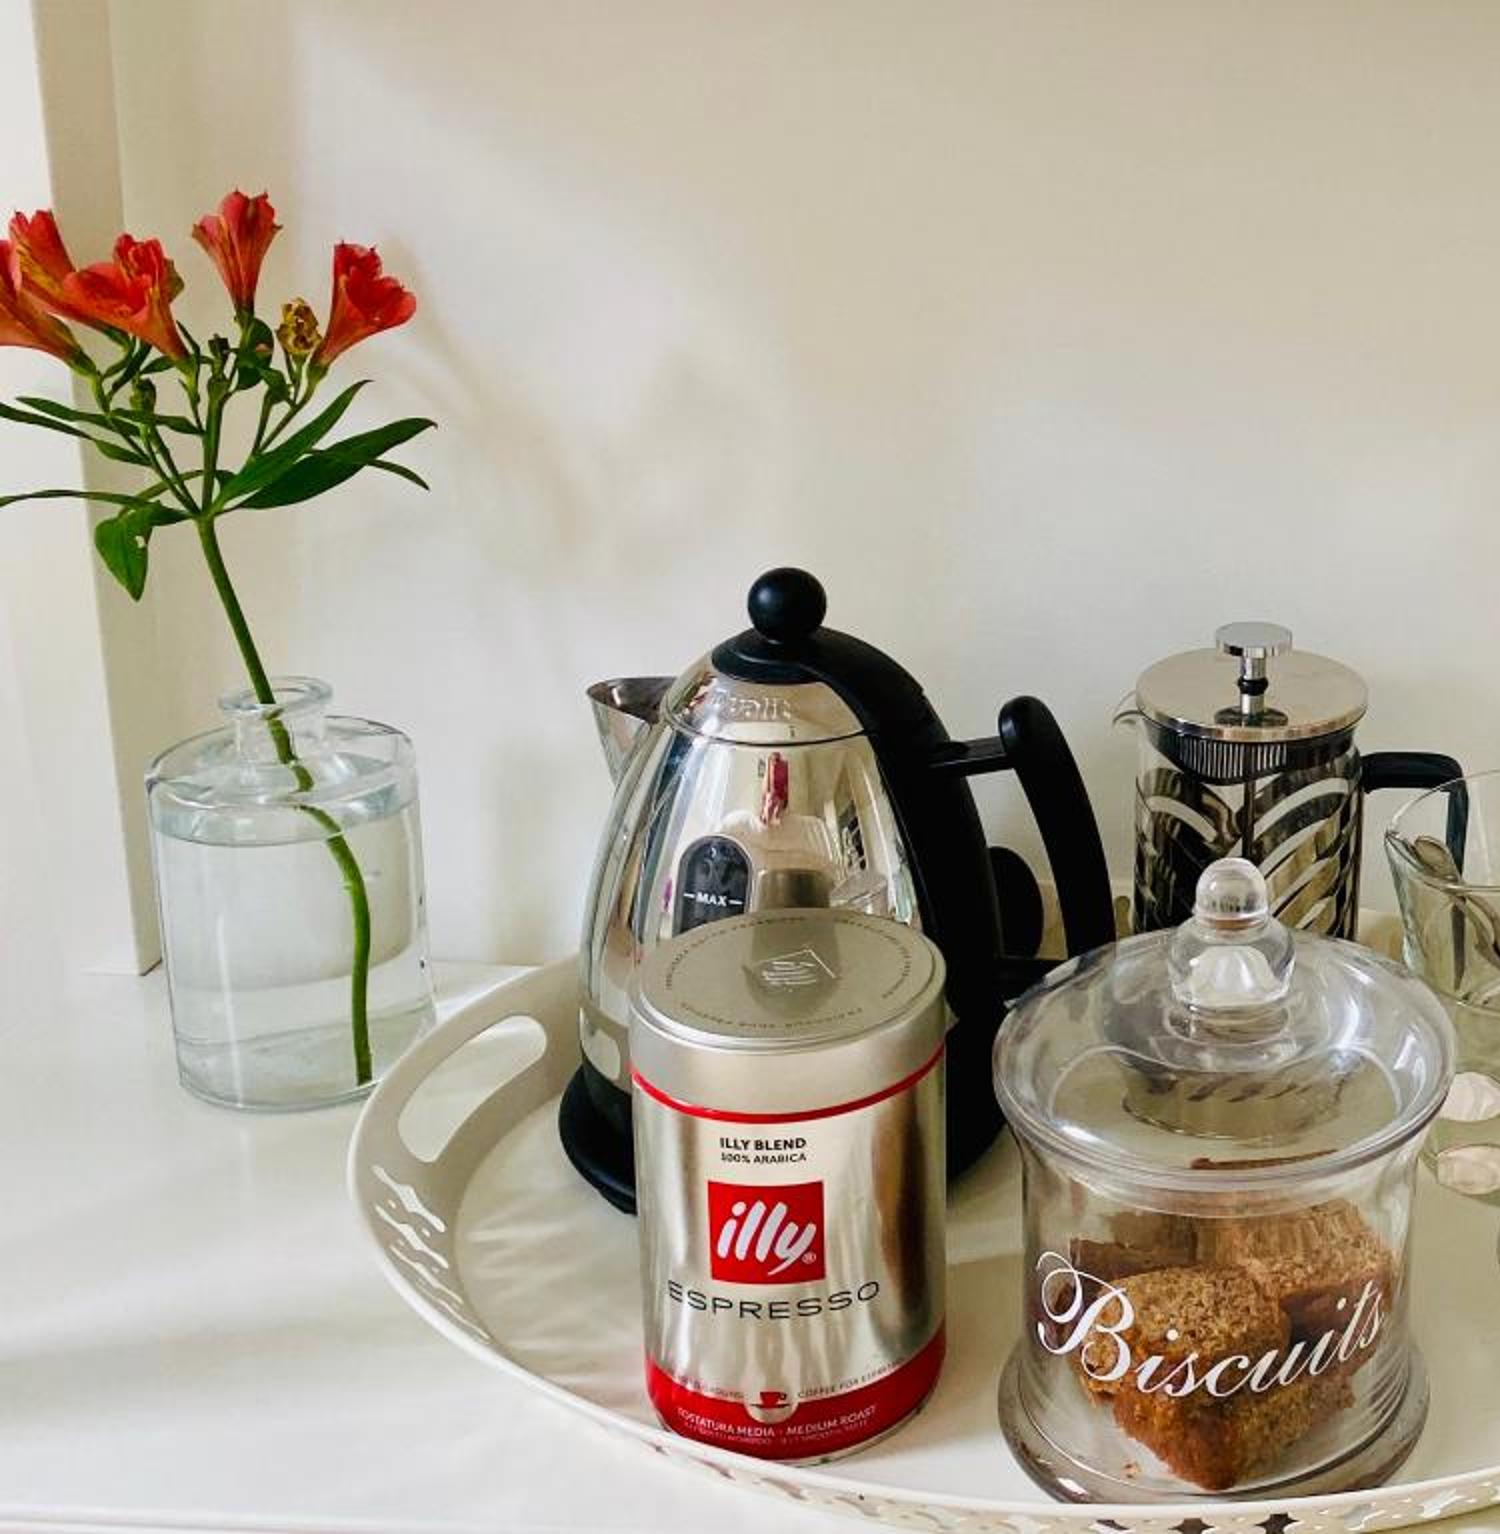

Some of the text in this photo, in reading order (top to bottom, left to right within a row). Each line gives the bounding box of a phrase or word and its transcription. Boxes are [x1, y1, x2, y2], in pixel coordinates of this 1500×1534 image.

[696, 891, 728, 907] MAX
[719, 1137, 807, 1151] ILLY BLEND
[753, 1153, 807, 1164] ARABICA
[717, 1200, 816, 1276] illy
[667, 1280, 881, 1320] ESPRESSO
[1036, 1251, 1385, 1398] Biscuits
[736, 1424, 775, 1438] MEDIA
